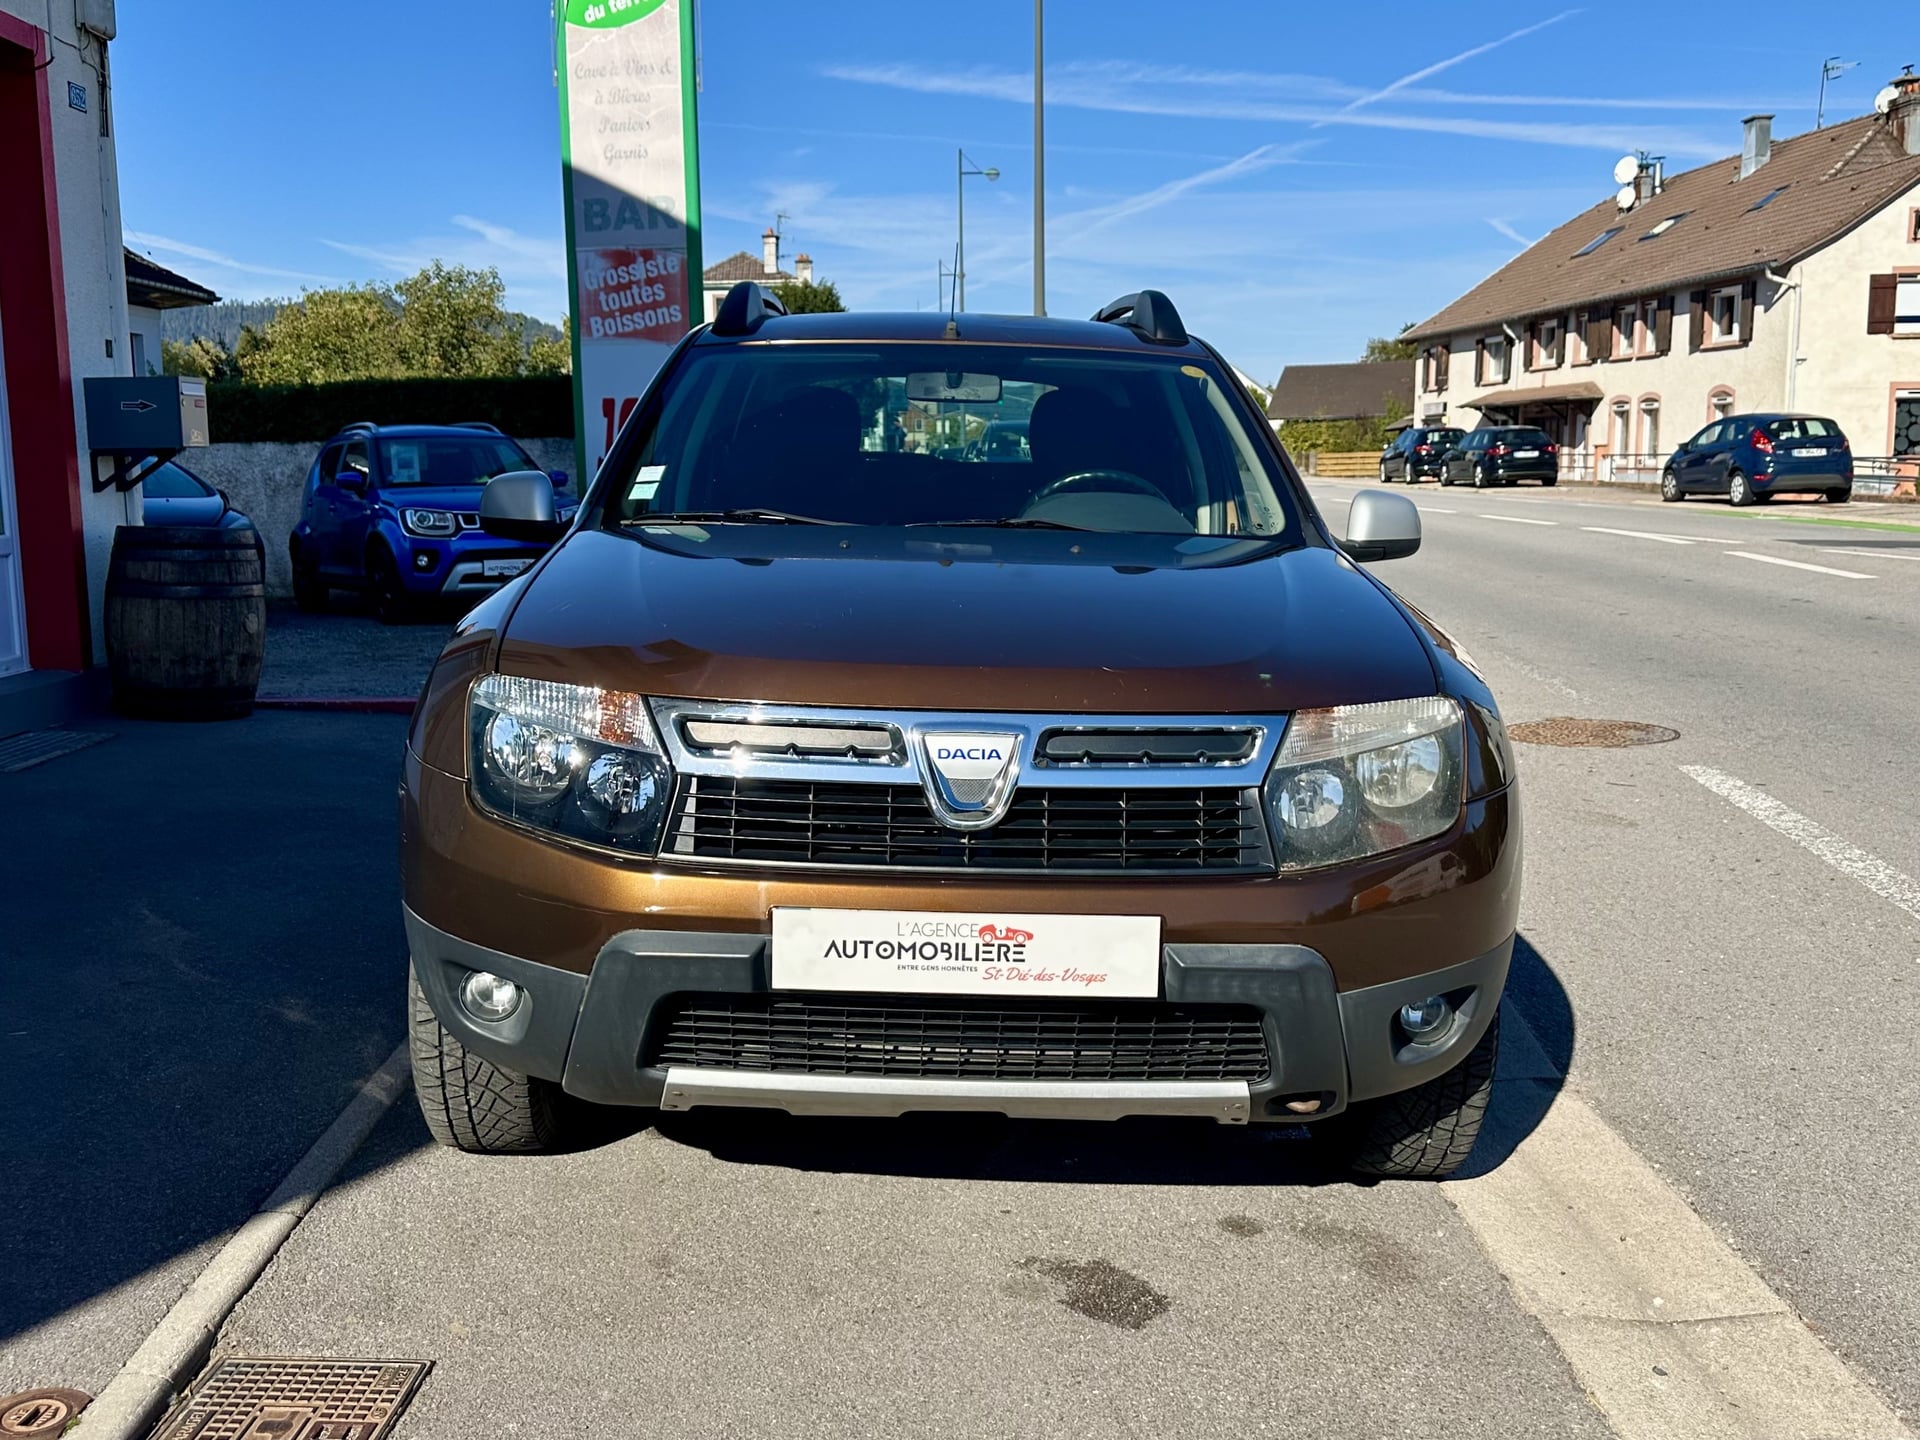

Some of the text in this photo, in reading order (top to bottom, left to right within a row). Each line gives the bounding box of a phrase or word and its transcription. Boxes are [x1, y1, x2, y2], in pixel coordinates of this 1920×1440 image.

[584, 4, 605, 23] du
[574, 62, 606, 80] Cave
[622, 58, 655, 76] Vins
[597, 114, 651, 134] Paniers
[603, 143, 649, 166] Garnis
[583, 195, 679, 232] BAR
[584, 255, 679, 290] Grossiste
[599, 282, 666, 312] toutes
[590, 304, 682, 338] Boissons
[937, 748, 1002, 760] DACIA
[897, 922, 979, 938] L'AGENCE
[982, 967, 1107, 987] St-Dié-des-Vosges
